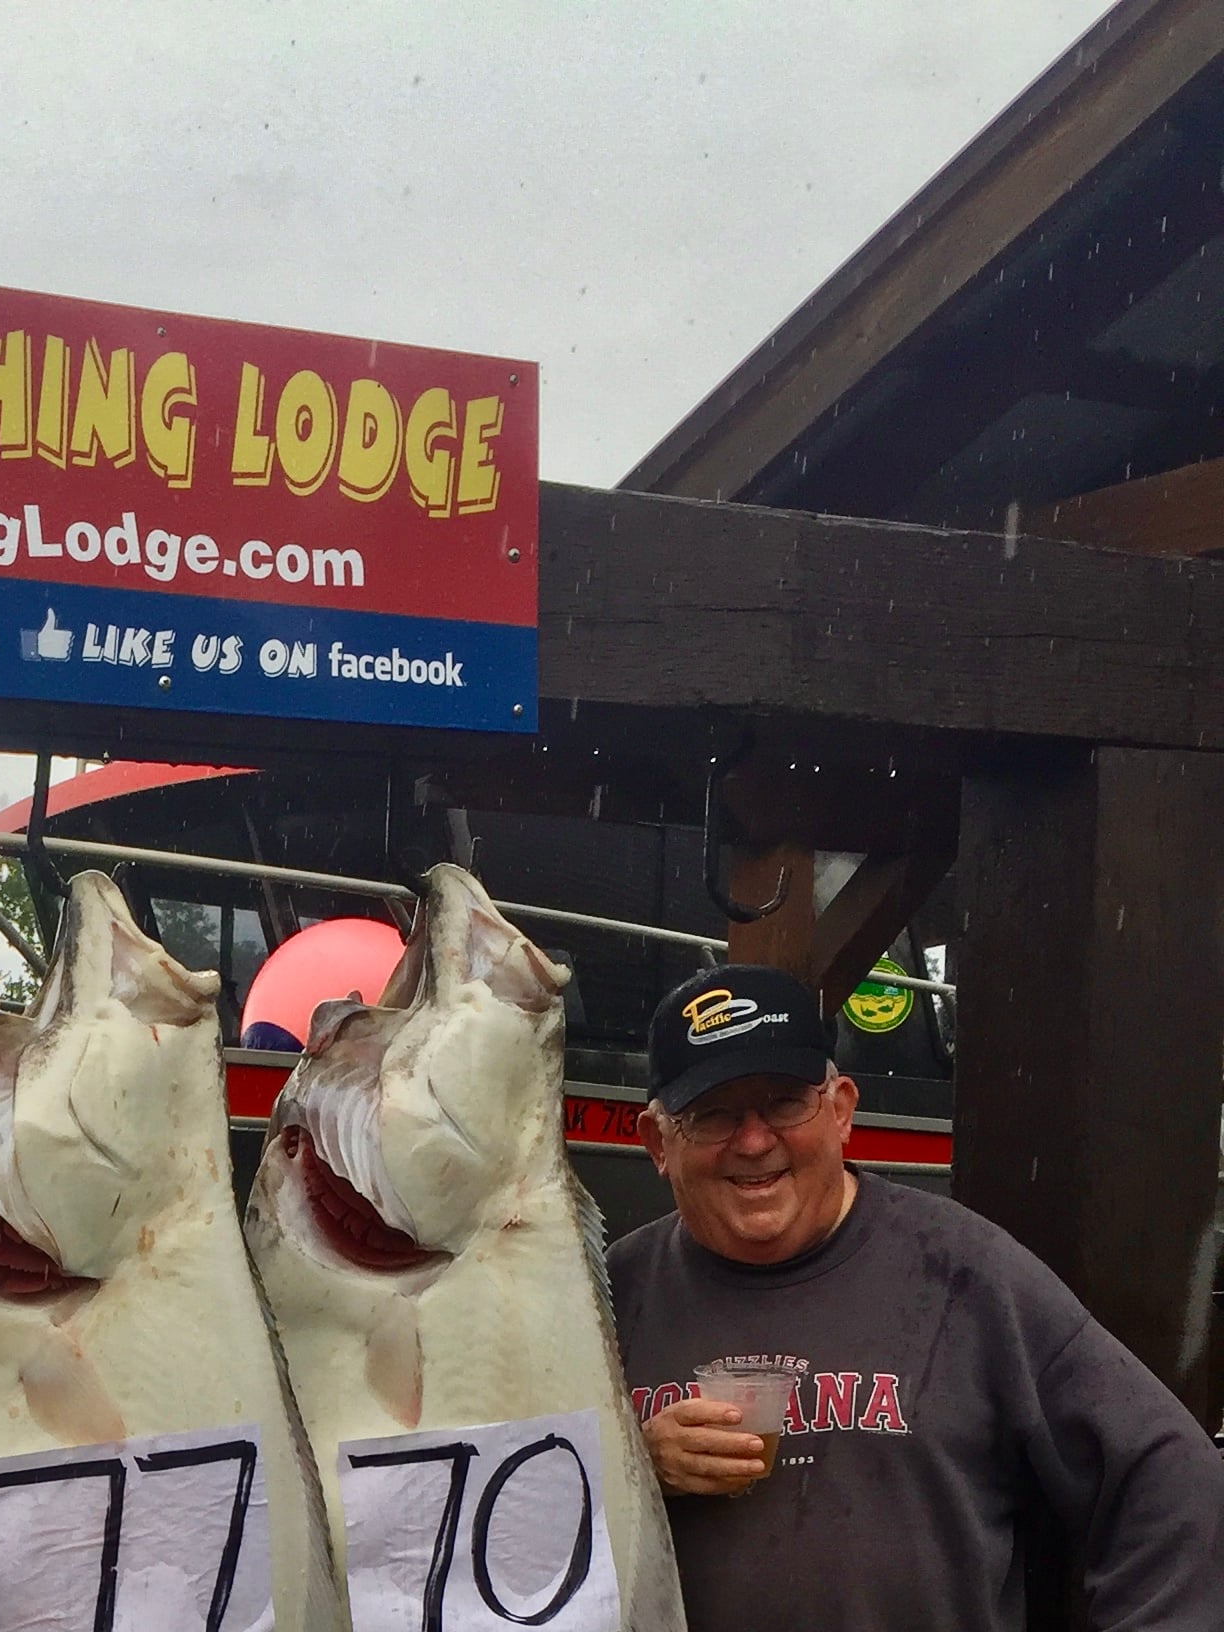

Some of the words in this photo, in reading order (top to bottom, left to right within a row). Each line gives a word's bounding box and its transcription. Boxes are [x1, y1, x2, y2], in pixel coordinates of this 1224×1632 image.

[231, 362, 505, 518] LODGE
[82, 622, 175, 669] LIKE
[191, 633, 243, 674] US
[259, 638, 318, 679] ON
[329, 642, 464, 687] facebook
[781, 1455, 814, 1466] 1893
